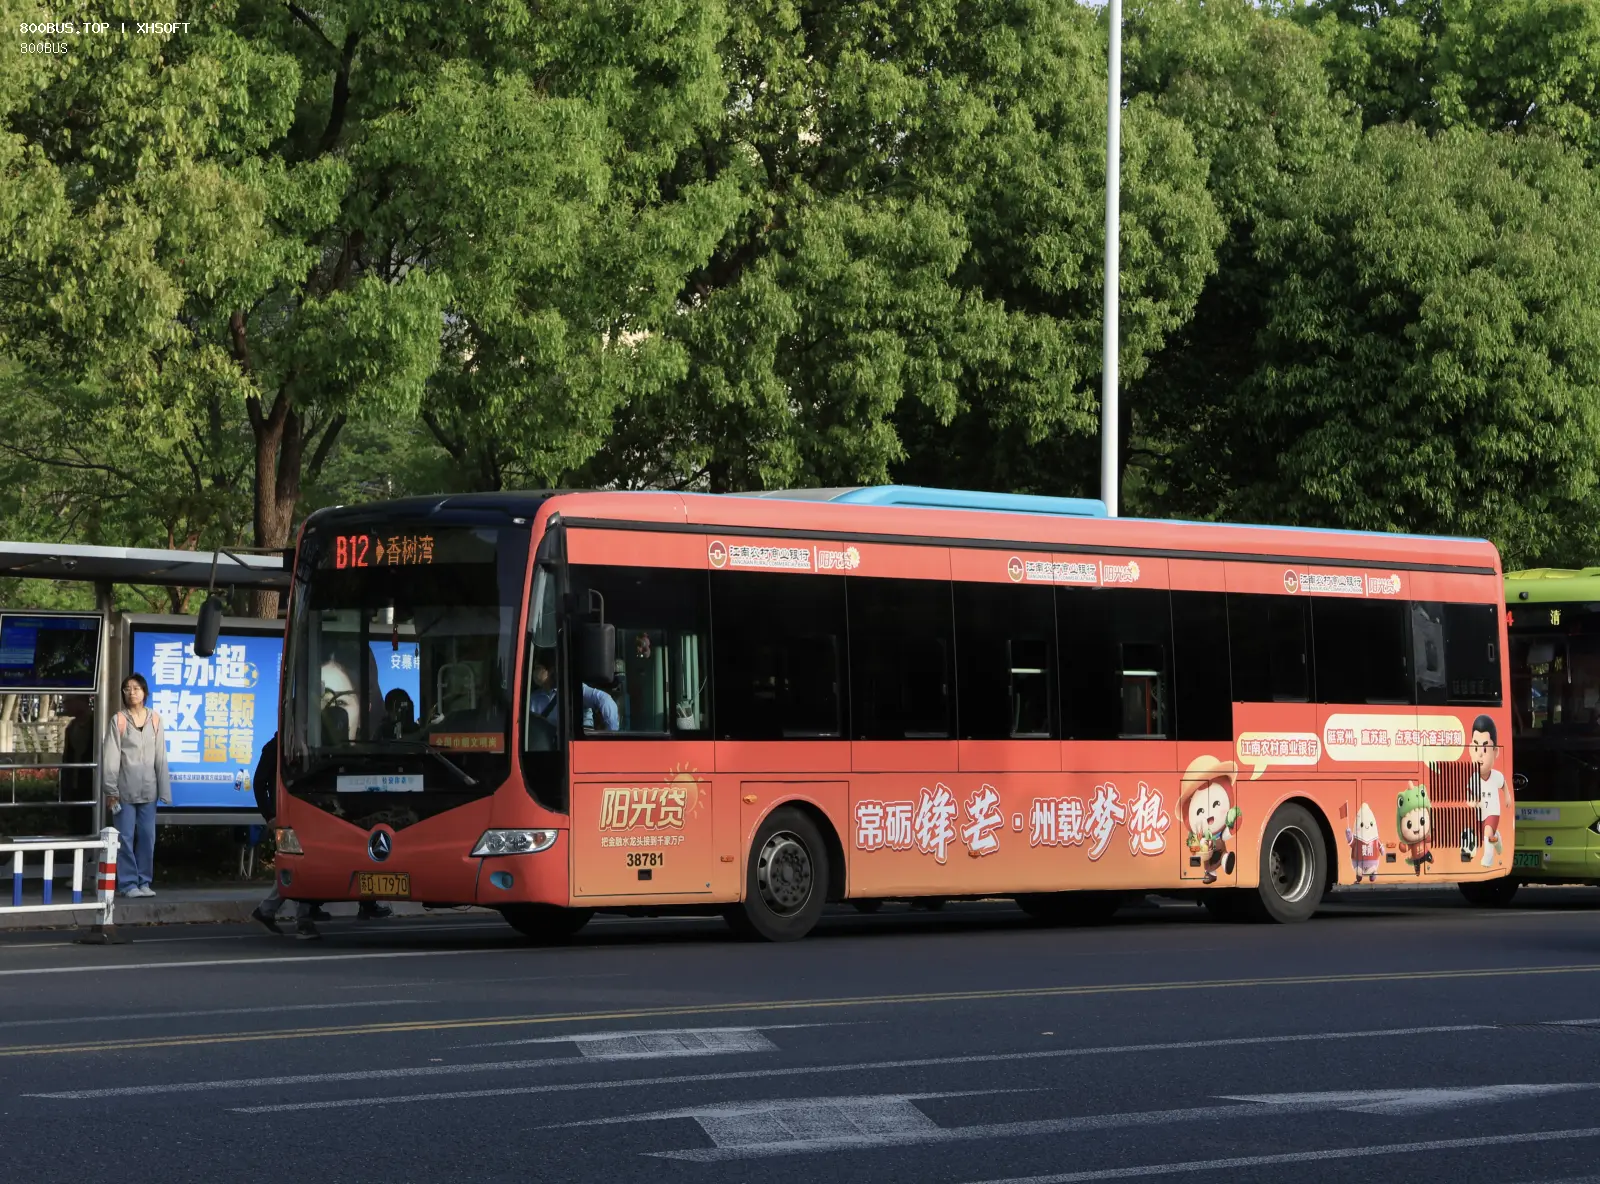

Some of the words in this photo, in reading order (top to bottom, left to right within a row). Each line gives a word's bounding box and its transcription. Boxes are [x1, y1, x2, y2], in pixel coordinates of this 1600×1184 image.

[335, 535, 369, 569] B12
[386, 535, 435, 566] 香树湾
[729, 545, 810, 562] 江南农村商业银行
[1025, 561, 1096, 576] 江南农村商业银行
[1300, 574, 1362, 588] 江南农村商业银行
[151, 641, 247, 688] 看苏超
[203, 691, 255, 728] 整颗
[203, 727, 254, 765] 蓝莓
[1240, 738, 1318, 757] 江南农村商业银行
[600, 788, 687, 830] 阳光贷
[601, 835, 685, 848] 把金融水龙头接到千家万户
[626, 853, 664, 867] 38781
